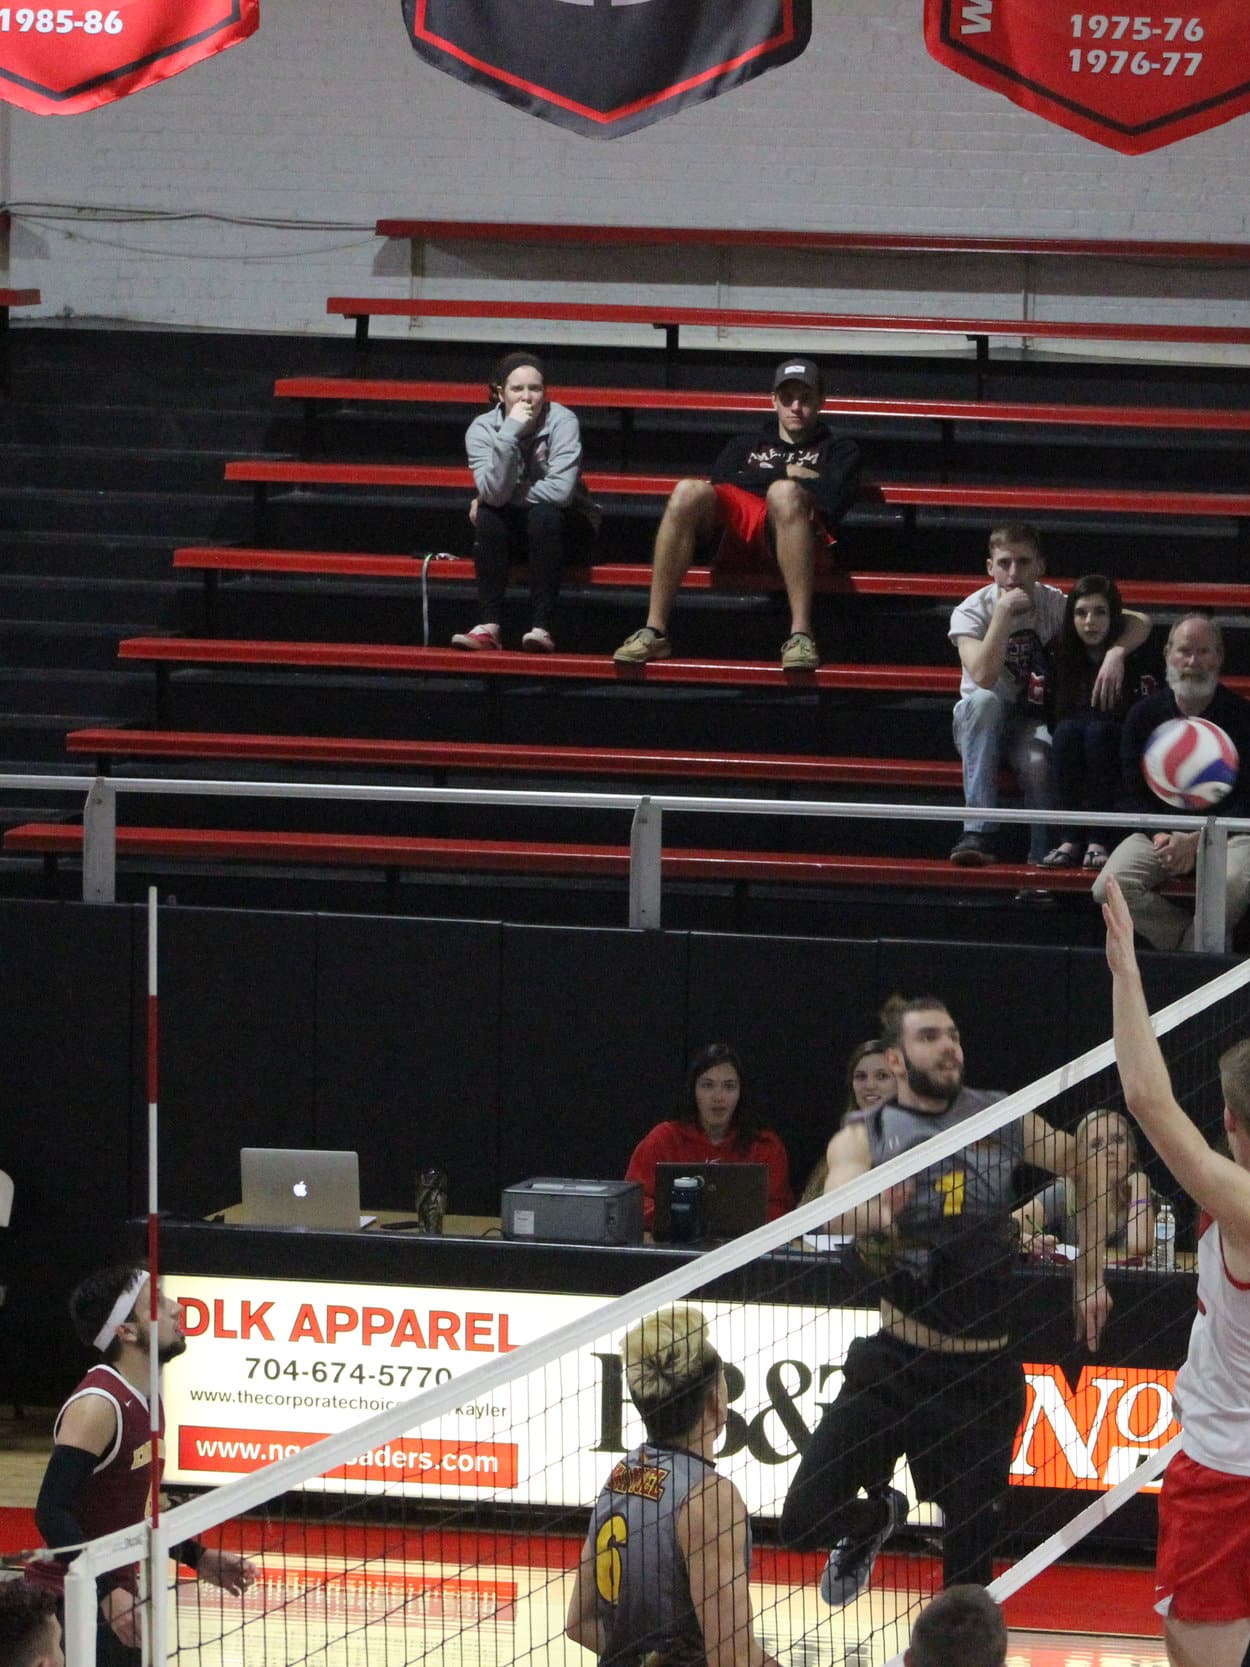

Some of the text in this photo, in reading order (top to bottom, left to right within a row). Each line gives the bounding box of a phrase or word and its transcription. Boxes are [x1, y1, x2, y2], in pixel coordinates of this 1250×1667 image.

[0, 8, 123, 34] 1985-86
[1070, 15, 1205, 41] 1975-76
[1069, 49, 1202, 76] 1976-77
[934, 1169, 965, 1217] 1
[177, 1297, 521, 1354] DLK APPAREL
[245, 1357, 453, 1389] 704-674-5770
[595, 1513, 628, 1606] 6
